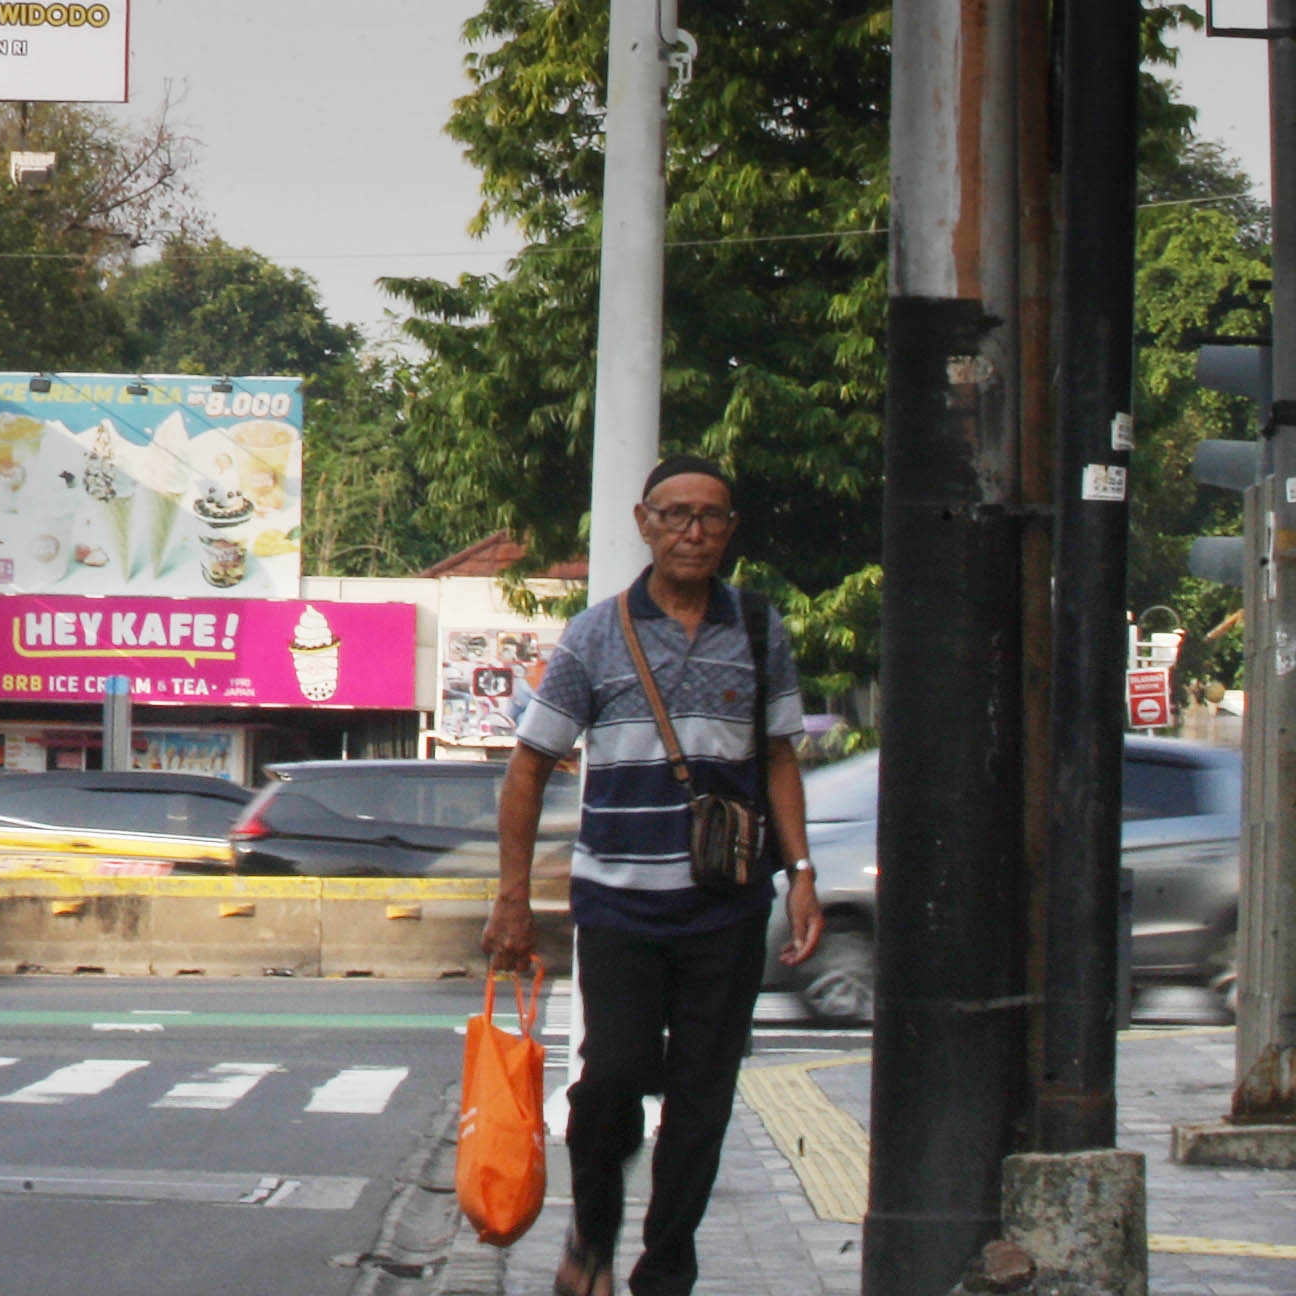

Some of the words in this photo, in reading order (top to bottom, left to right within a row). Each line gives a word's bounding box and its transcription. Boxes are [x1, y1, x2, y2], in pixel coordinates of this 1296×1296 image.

[11, 40, 28, 56] RI
[205, 392, 292, 418] 8.000
[24, 612, 103, 647] HEY
[48, 675, 79, 692] ICE
[84, 676, 152, 694] CRM
[171, 678, 209, 696] TEA
